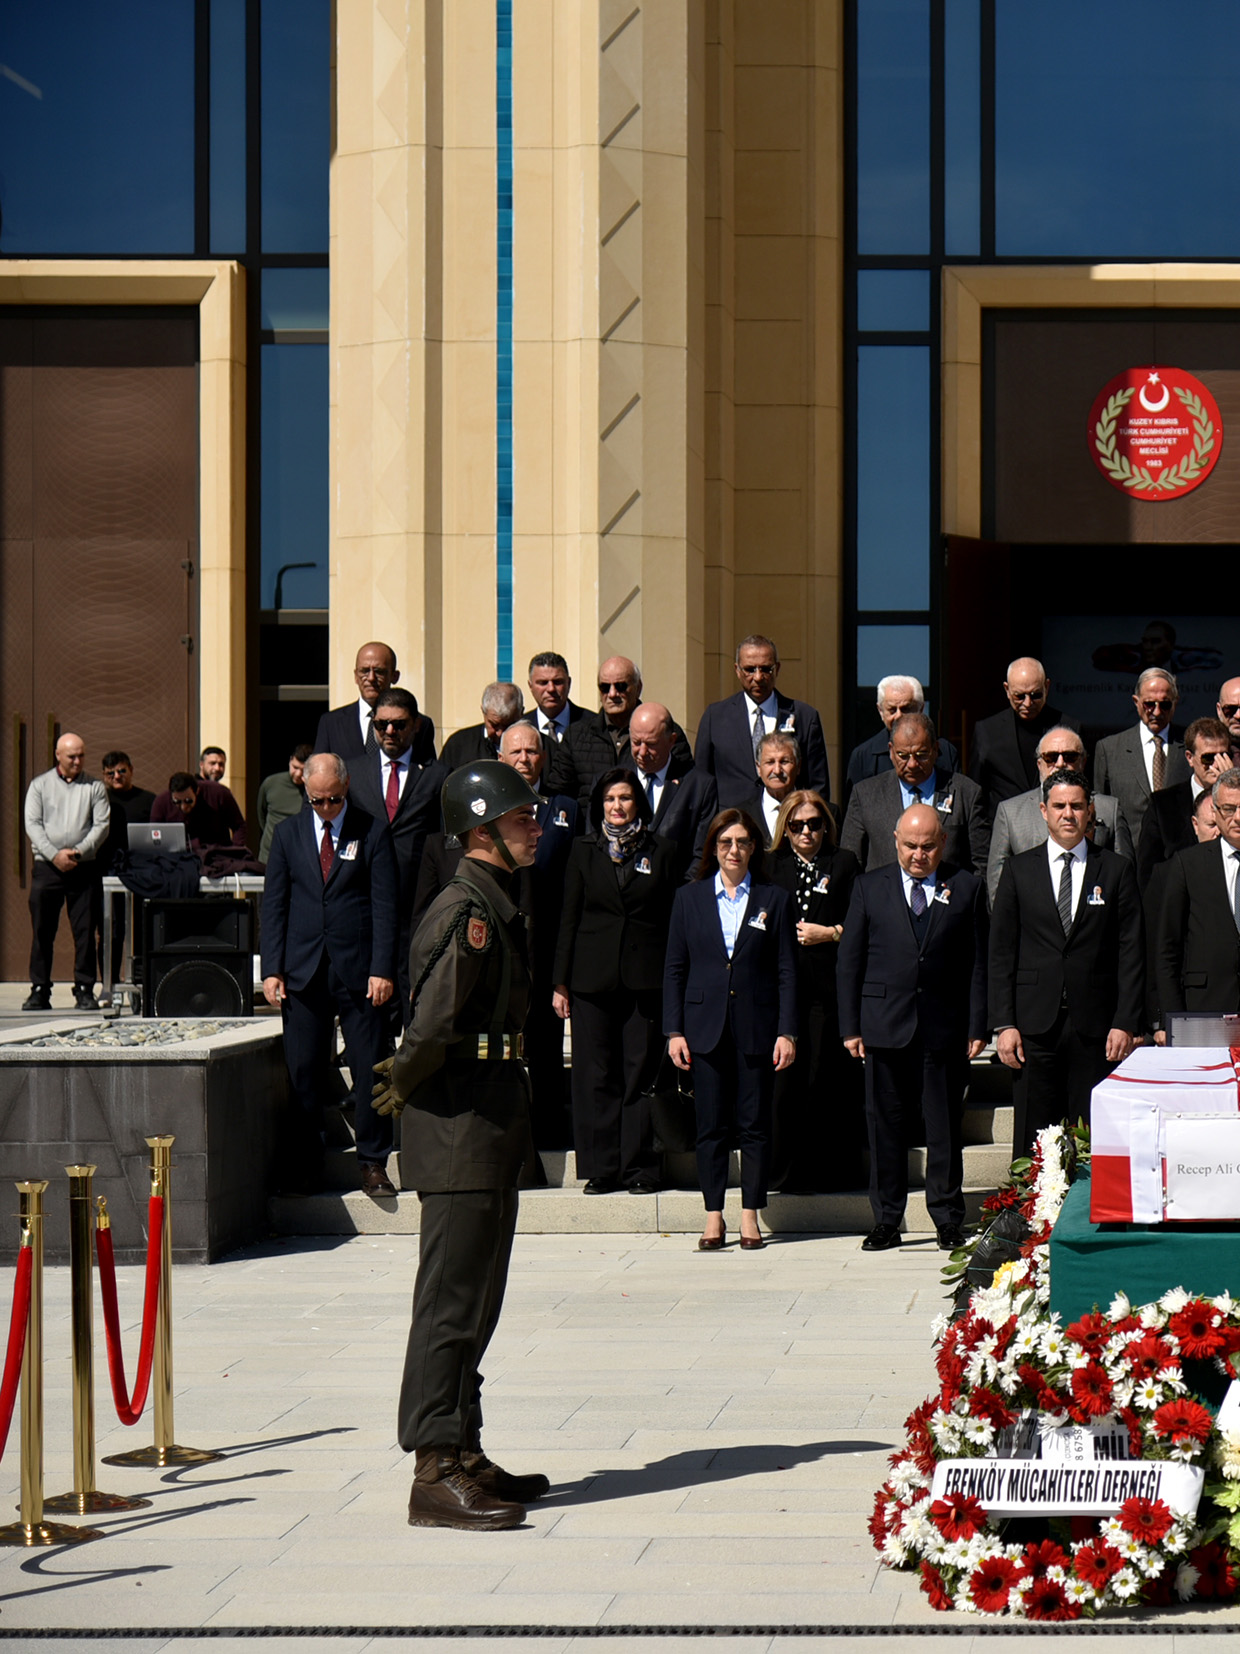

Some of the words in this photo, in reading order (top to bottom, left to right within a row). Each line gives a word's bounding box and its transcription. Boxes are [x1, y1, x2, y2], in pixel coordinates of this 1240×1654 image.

[1119, 427, 1139, 435] TÜRK
[1139, 427, 1189, 435] CUMHURİYETİ
[1130, 436, 1178, 445] CUMHURİYET
[1139, 446, 1169, 454] MECLİSİ
[1176, 1162, 1212, 1177] Recep
[1215, 1162, 1233, 1175] Ali
[944, 1462, 1007, 1502] ERENKÖY
[1007, 1462, 1100, 1503] MÜCAHİTLERİ
[1101, 1463, 1162, 1505] DERNEĞİ
